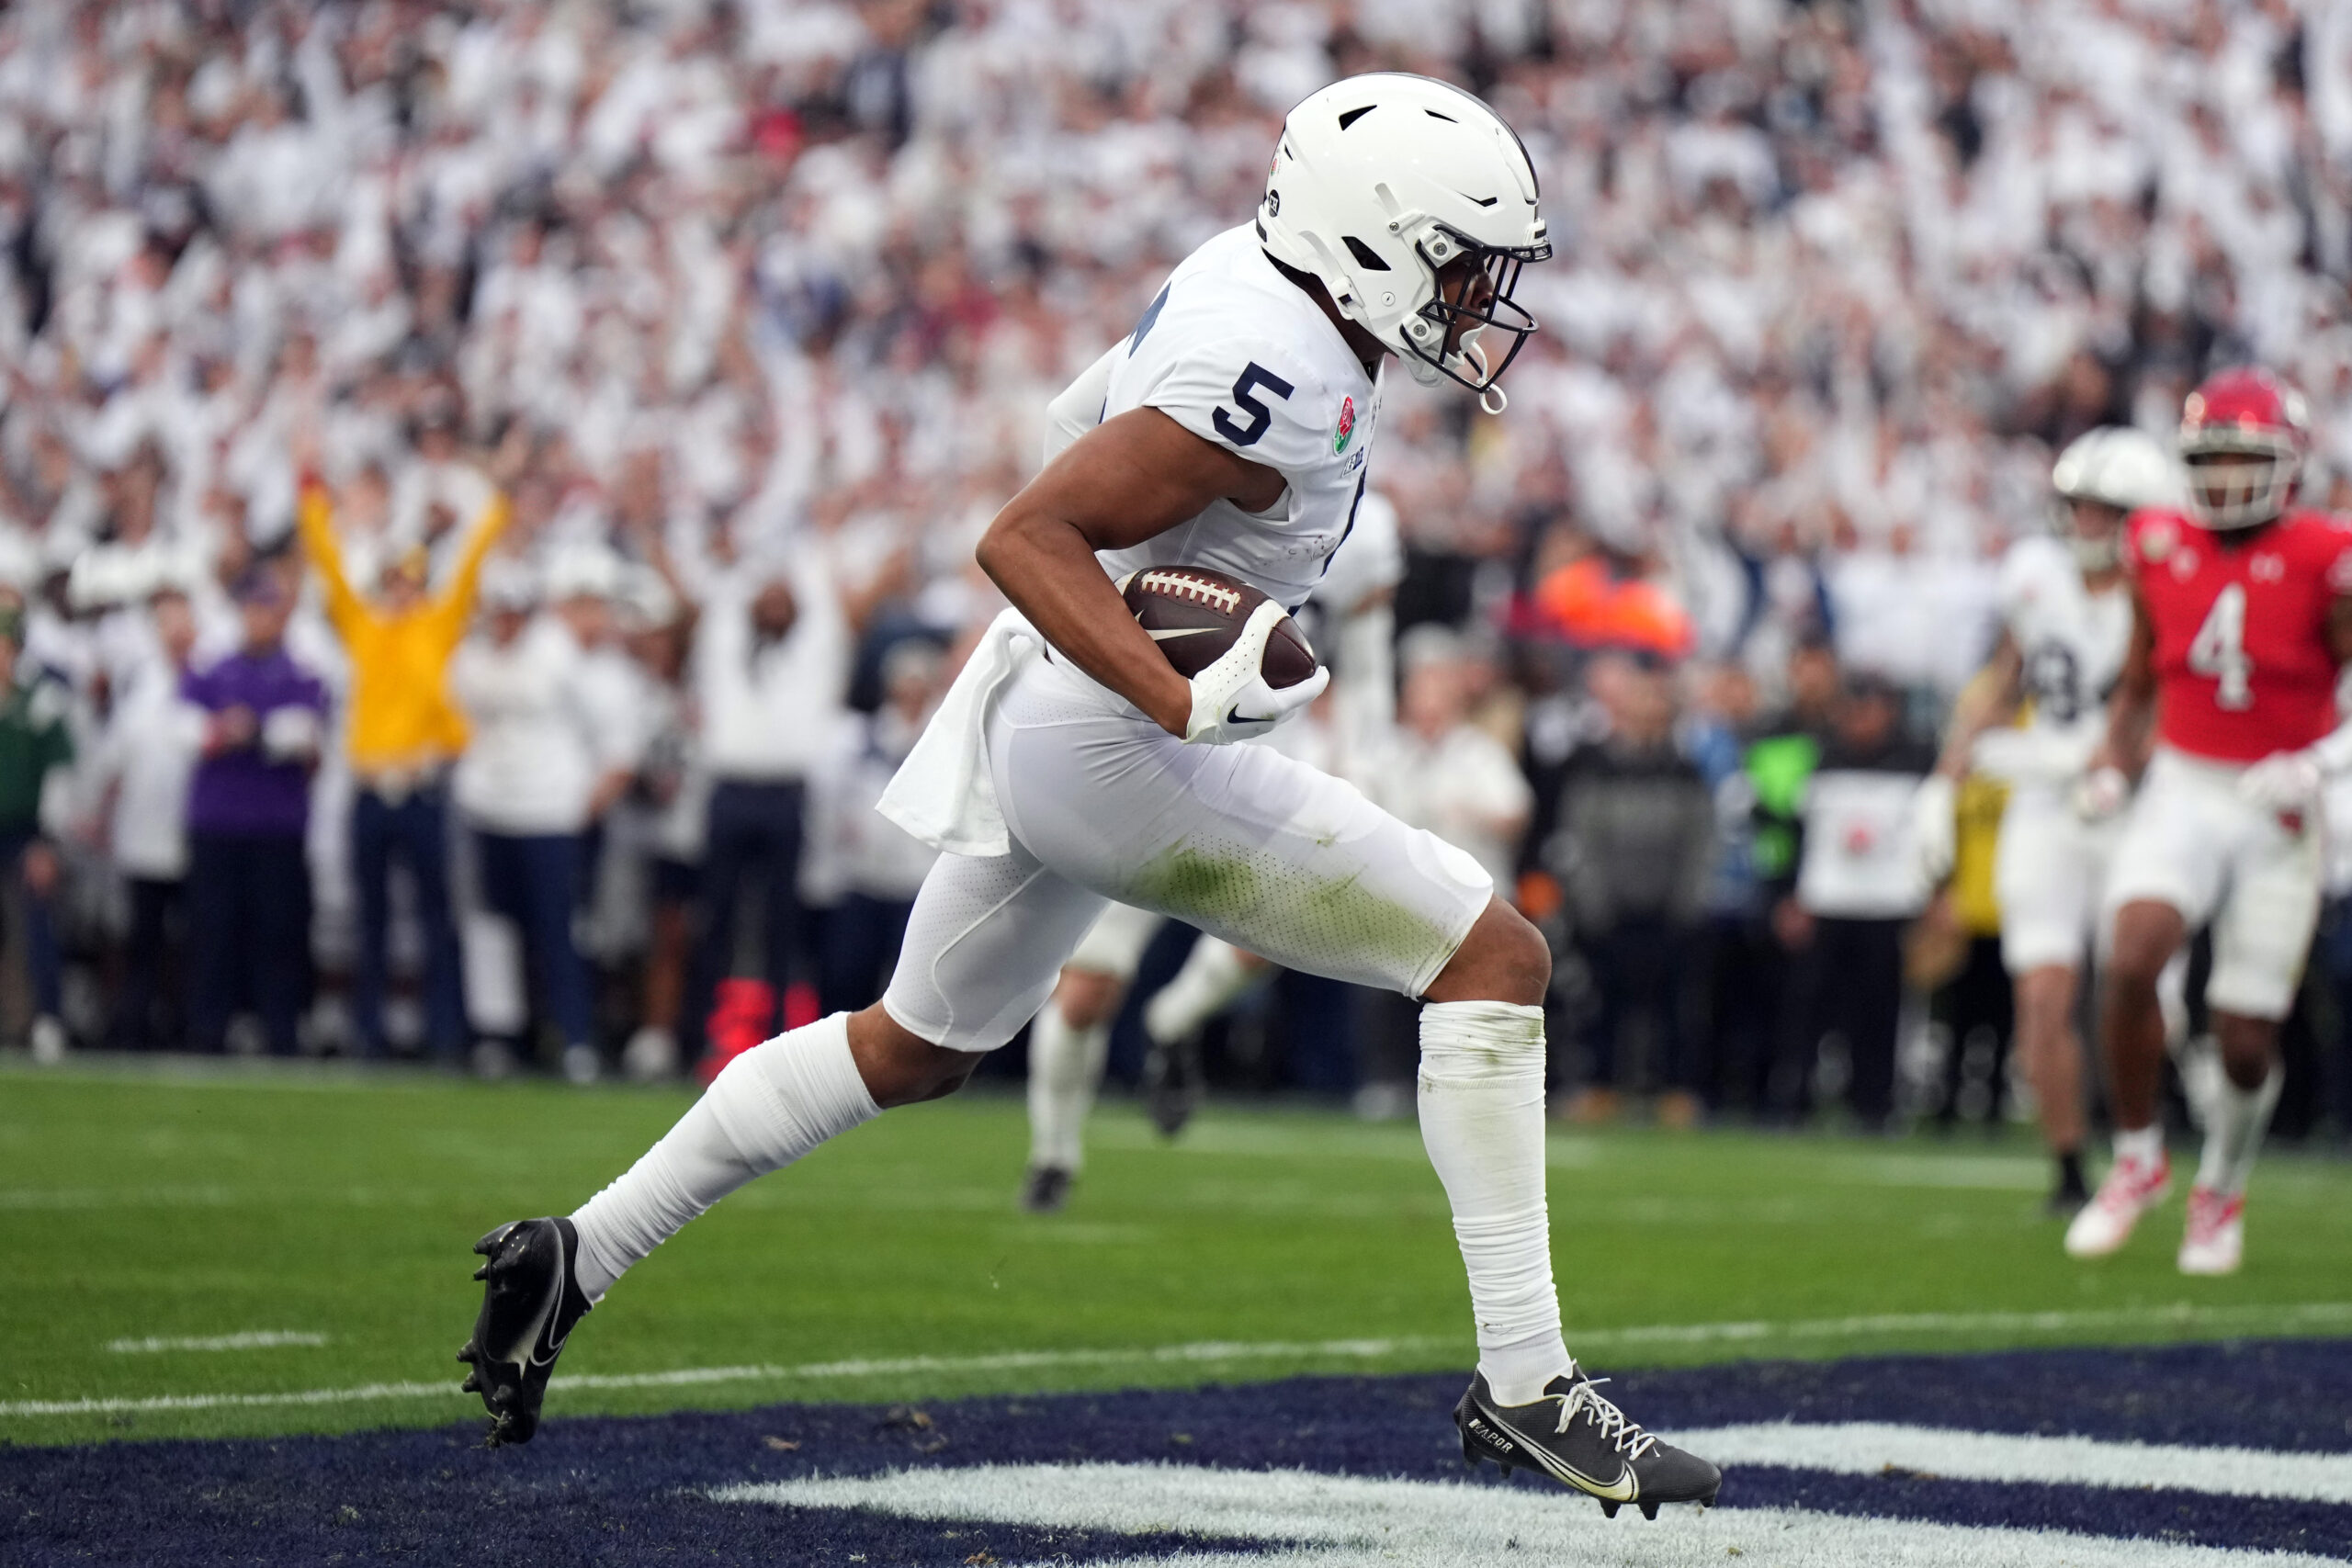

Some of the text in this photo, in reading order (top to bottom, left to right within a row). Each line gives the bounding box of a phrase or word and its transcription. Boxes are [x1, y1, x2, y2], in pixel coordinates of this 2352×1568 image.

[1212, 361, 1295, 446] 5
[2187, 581, 2256, 712] 4
[1475, 1425, 1514, 1451] VAPOR
